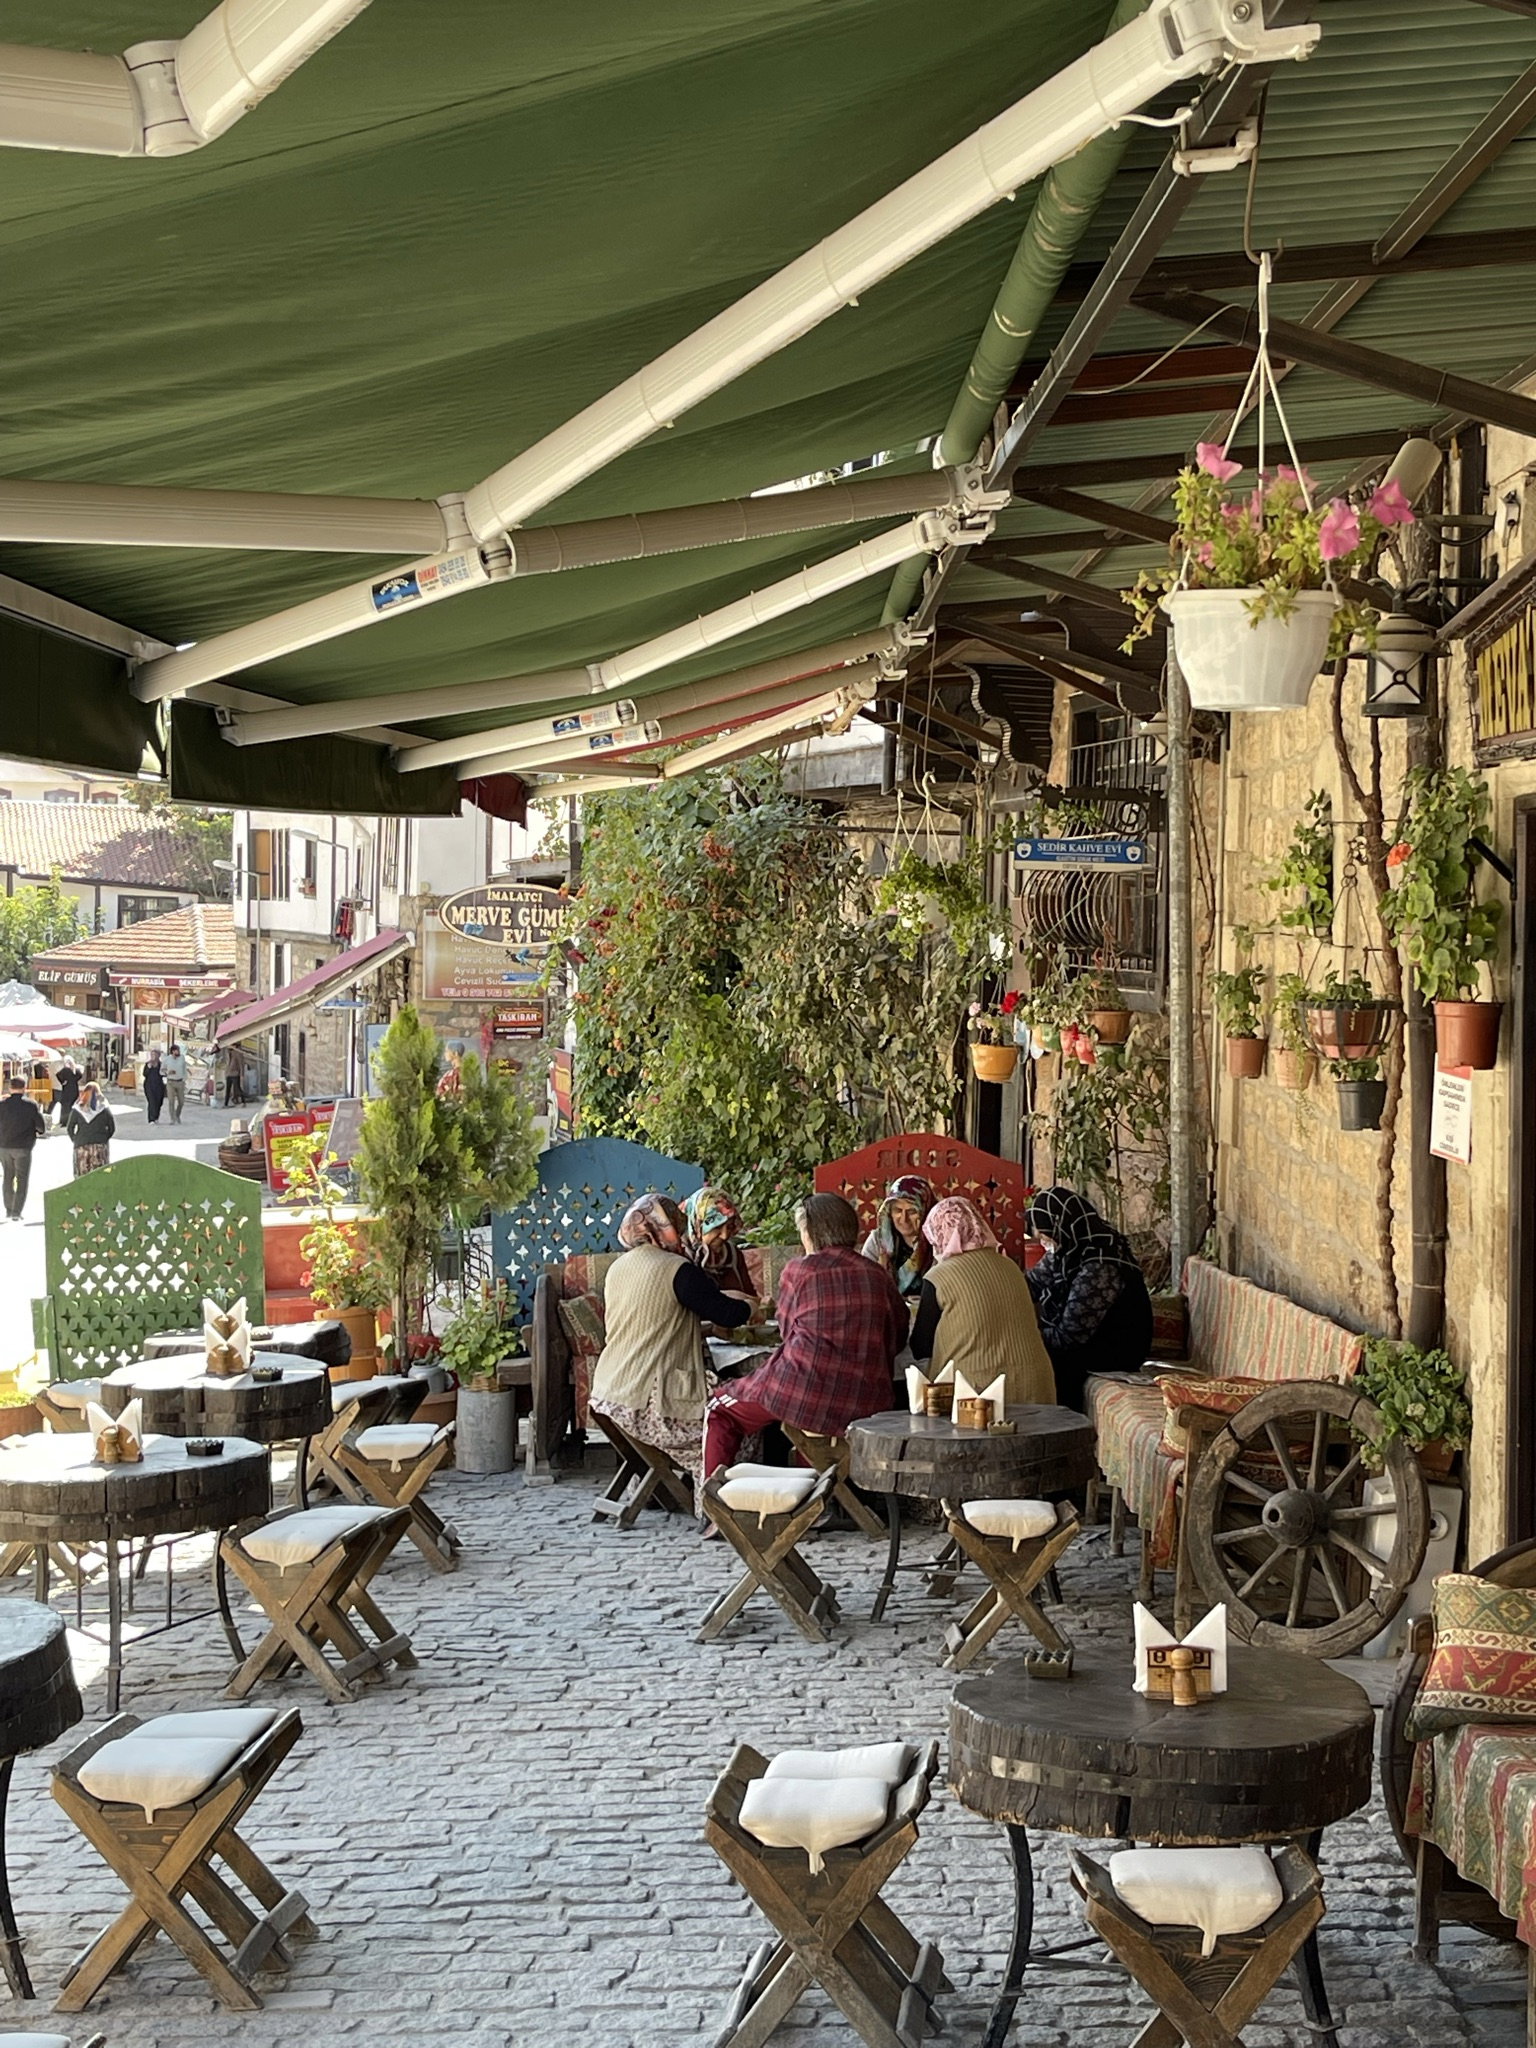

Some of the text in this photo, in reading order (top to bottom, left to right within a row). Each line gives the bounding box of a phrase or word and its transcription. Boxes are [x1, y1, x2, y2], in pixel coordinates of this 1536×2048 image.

[1037, 842, 1122, 854] SEDİR KAHVE EVİ
[451, 906, 513, 926] MERVE
[503, 926, 533, 943] EVİ
[38, 970, 97, 986] ELİF GÜMÜŞ
